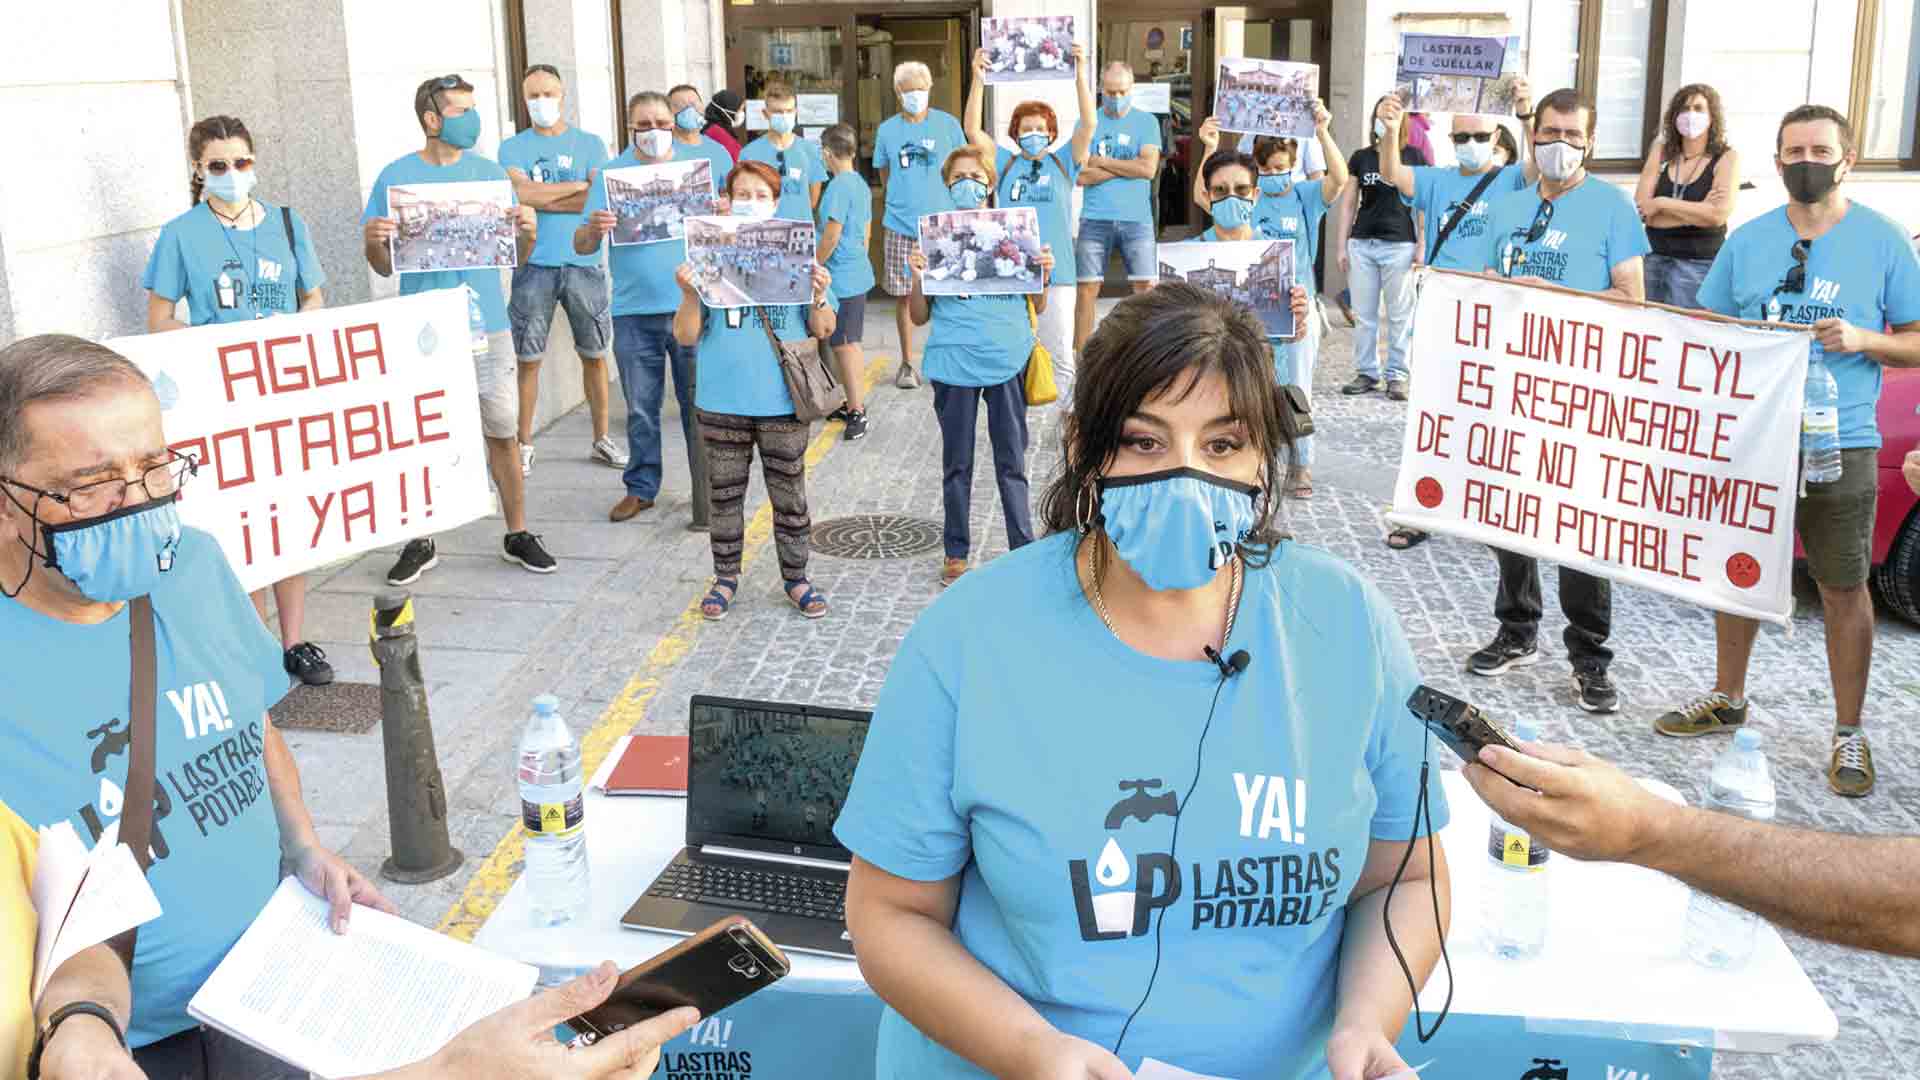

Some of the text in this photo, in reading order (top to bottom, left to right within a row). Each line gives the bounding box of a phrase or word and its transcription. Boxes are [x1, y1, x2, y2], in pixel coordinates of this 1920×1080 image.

[1408, 56, 1425, 66] DE
[1422, 44, 1484, 55] LASTRAS
[1542, 228, 1568, 250] YA!
[1809, 276, 1840, 304] YA!
[217, 323, 386, 402] AGUA
[1455, 300, 1756, 401] LA JUNTA DE CYL
[1457, 360, 1738, 463] ES RESPONSABLE
[1417, 411, 1779, 535] DE QUE NO TENGAMOS
[1463, 478, 1704, 582] AGUA POTABLE
[165, 681, 233, 740] YA!
[166, 721, 264, 803] LASTRAS
[1232, 772, 1306, 845] YA!
[1192, 847, 1341, 900] LASTRAS
[1191, 889, 1338, 931] POTABLE
[689, 1016, 734, 1049] YA!
[663, 1051, 752, 1073] LASTRAS
